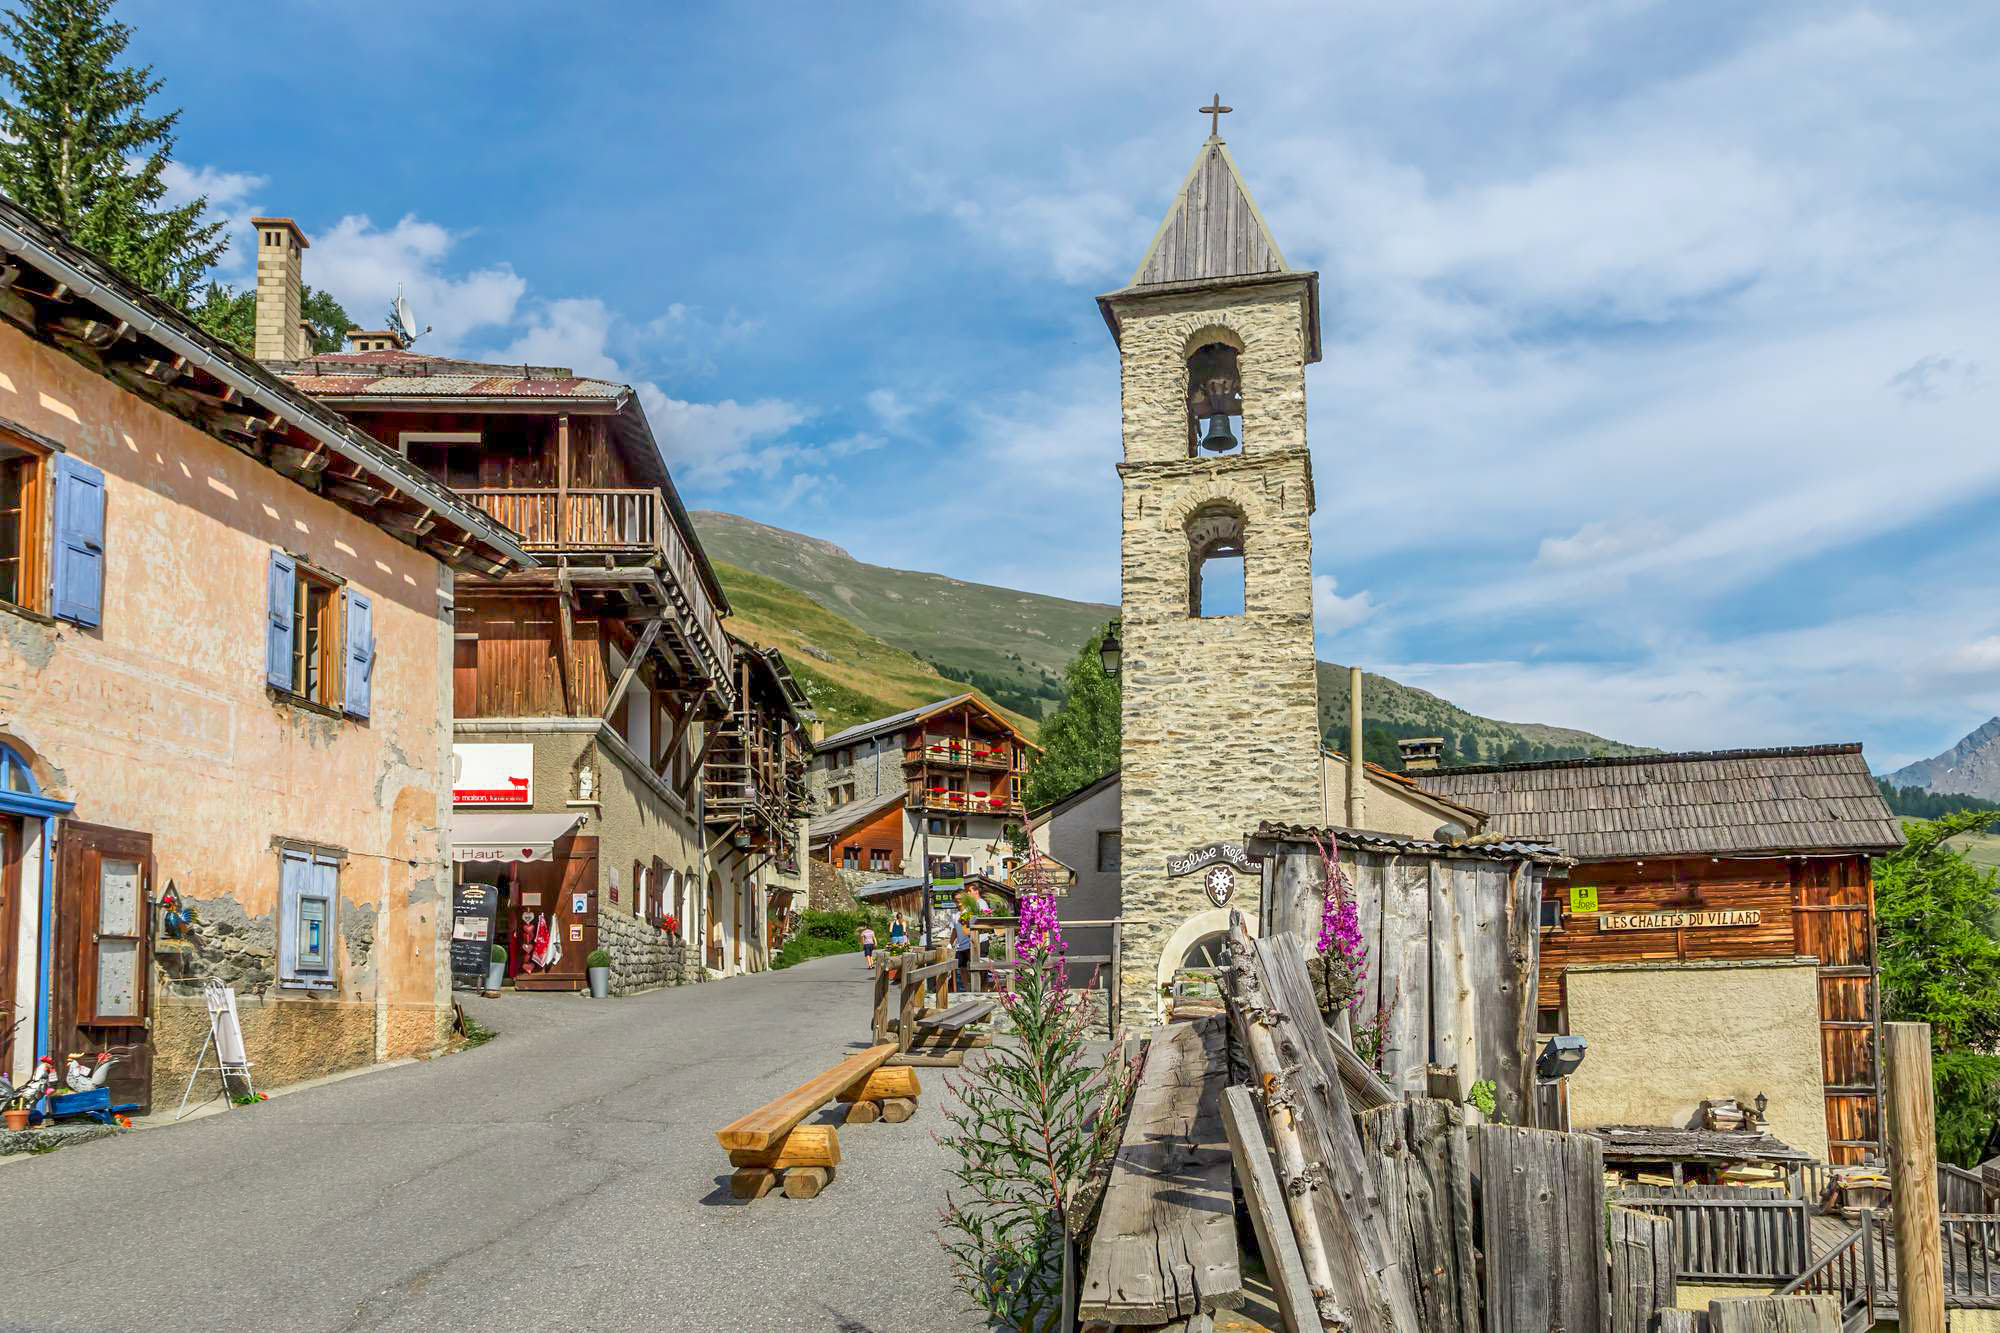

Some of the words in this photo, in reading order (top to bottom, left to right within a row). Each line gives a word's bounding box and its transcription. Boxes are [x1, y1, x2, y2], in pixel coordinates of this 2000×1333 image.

[462, 848, 505, 859] Haut
[1171, 847, 1217, 873] Eglise
[1573, 898, 1596, 910] Logis
[1606, 916, 1627, 929] LES
[1629, 913, 1684, 928] CHALETS
[1689, 913, 1704, 926] DU
[1708, 911, 1761, 925] VILLARD
